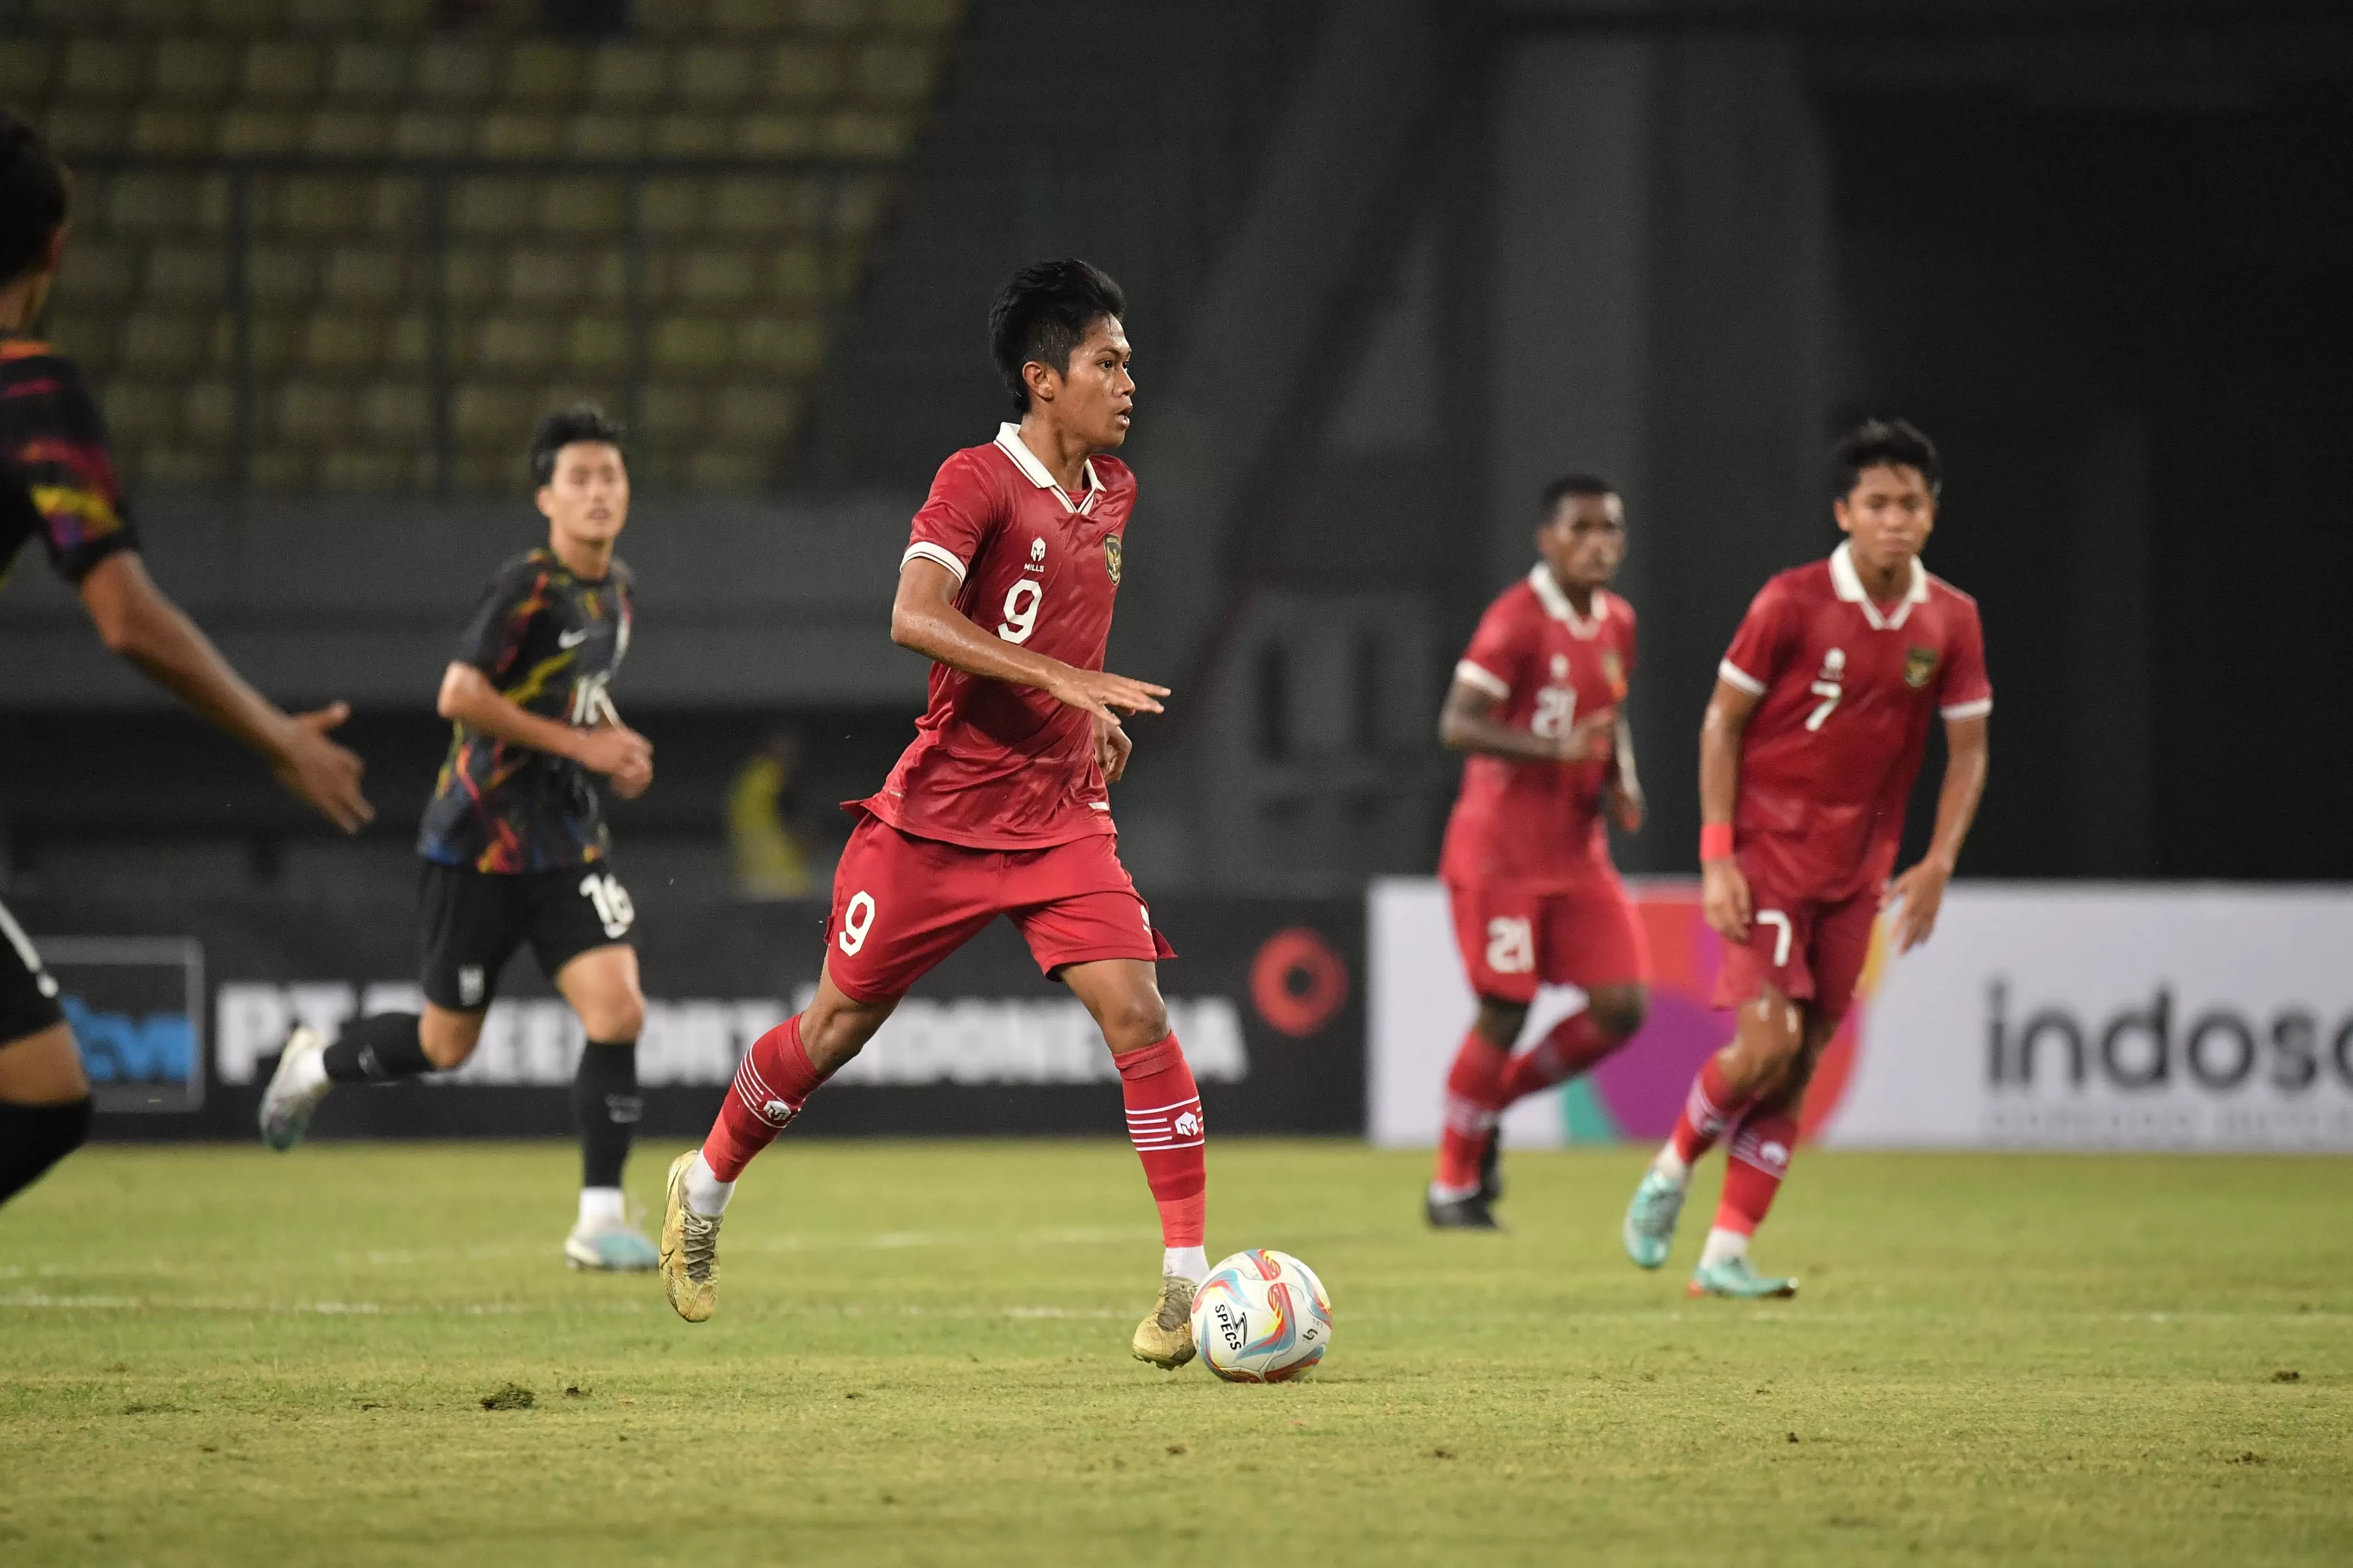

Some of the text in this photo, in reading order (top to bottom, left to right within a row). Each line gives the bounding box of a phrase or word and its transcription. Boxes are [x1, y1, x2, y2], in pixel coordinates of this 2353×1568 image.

[1024, 563, 1044, 572] MILLS
[998, 578, 1042, 644] 9
[1805, 680, 1841, 731] 7
[579, 873, 635, 939] 16
[839, 891, 876, 957] 9
[1486, 915, 1534, 974] 21
[1756, 909, 1791, 967] 7
[1214, 1304, 1242, 1351] SPECS
